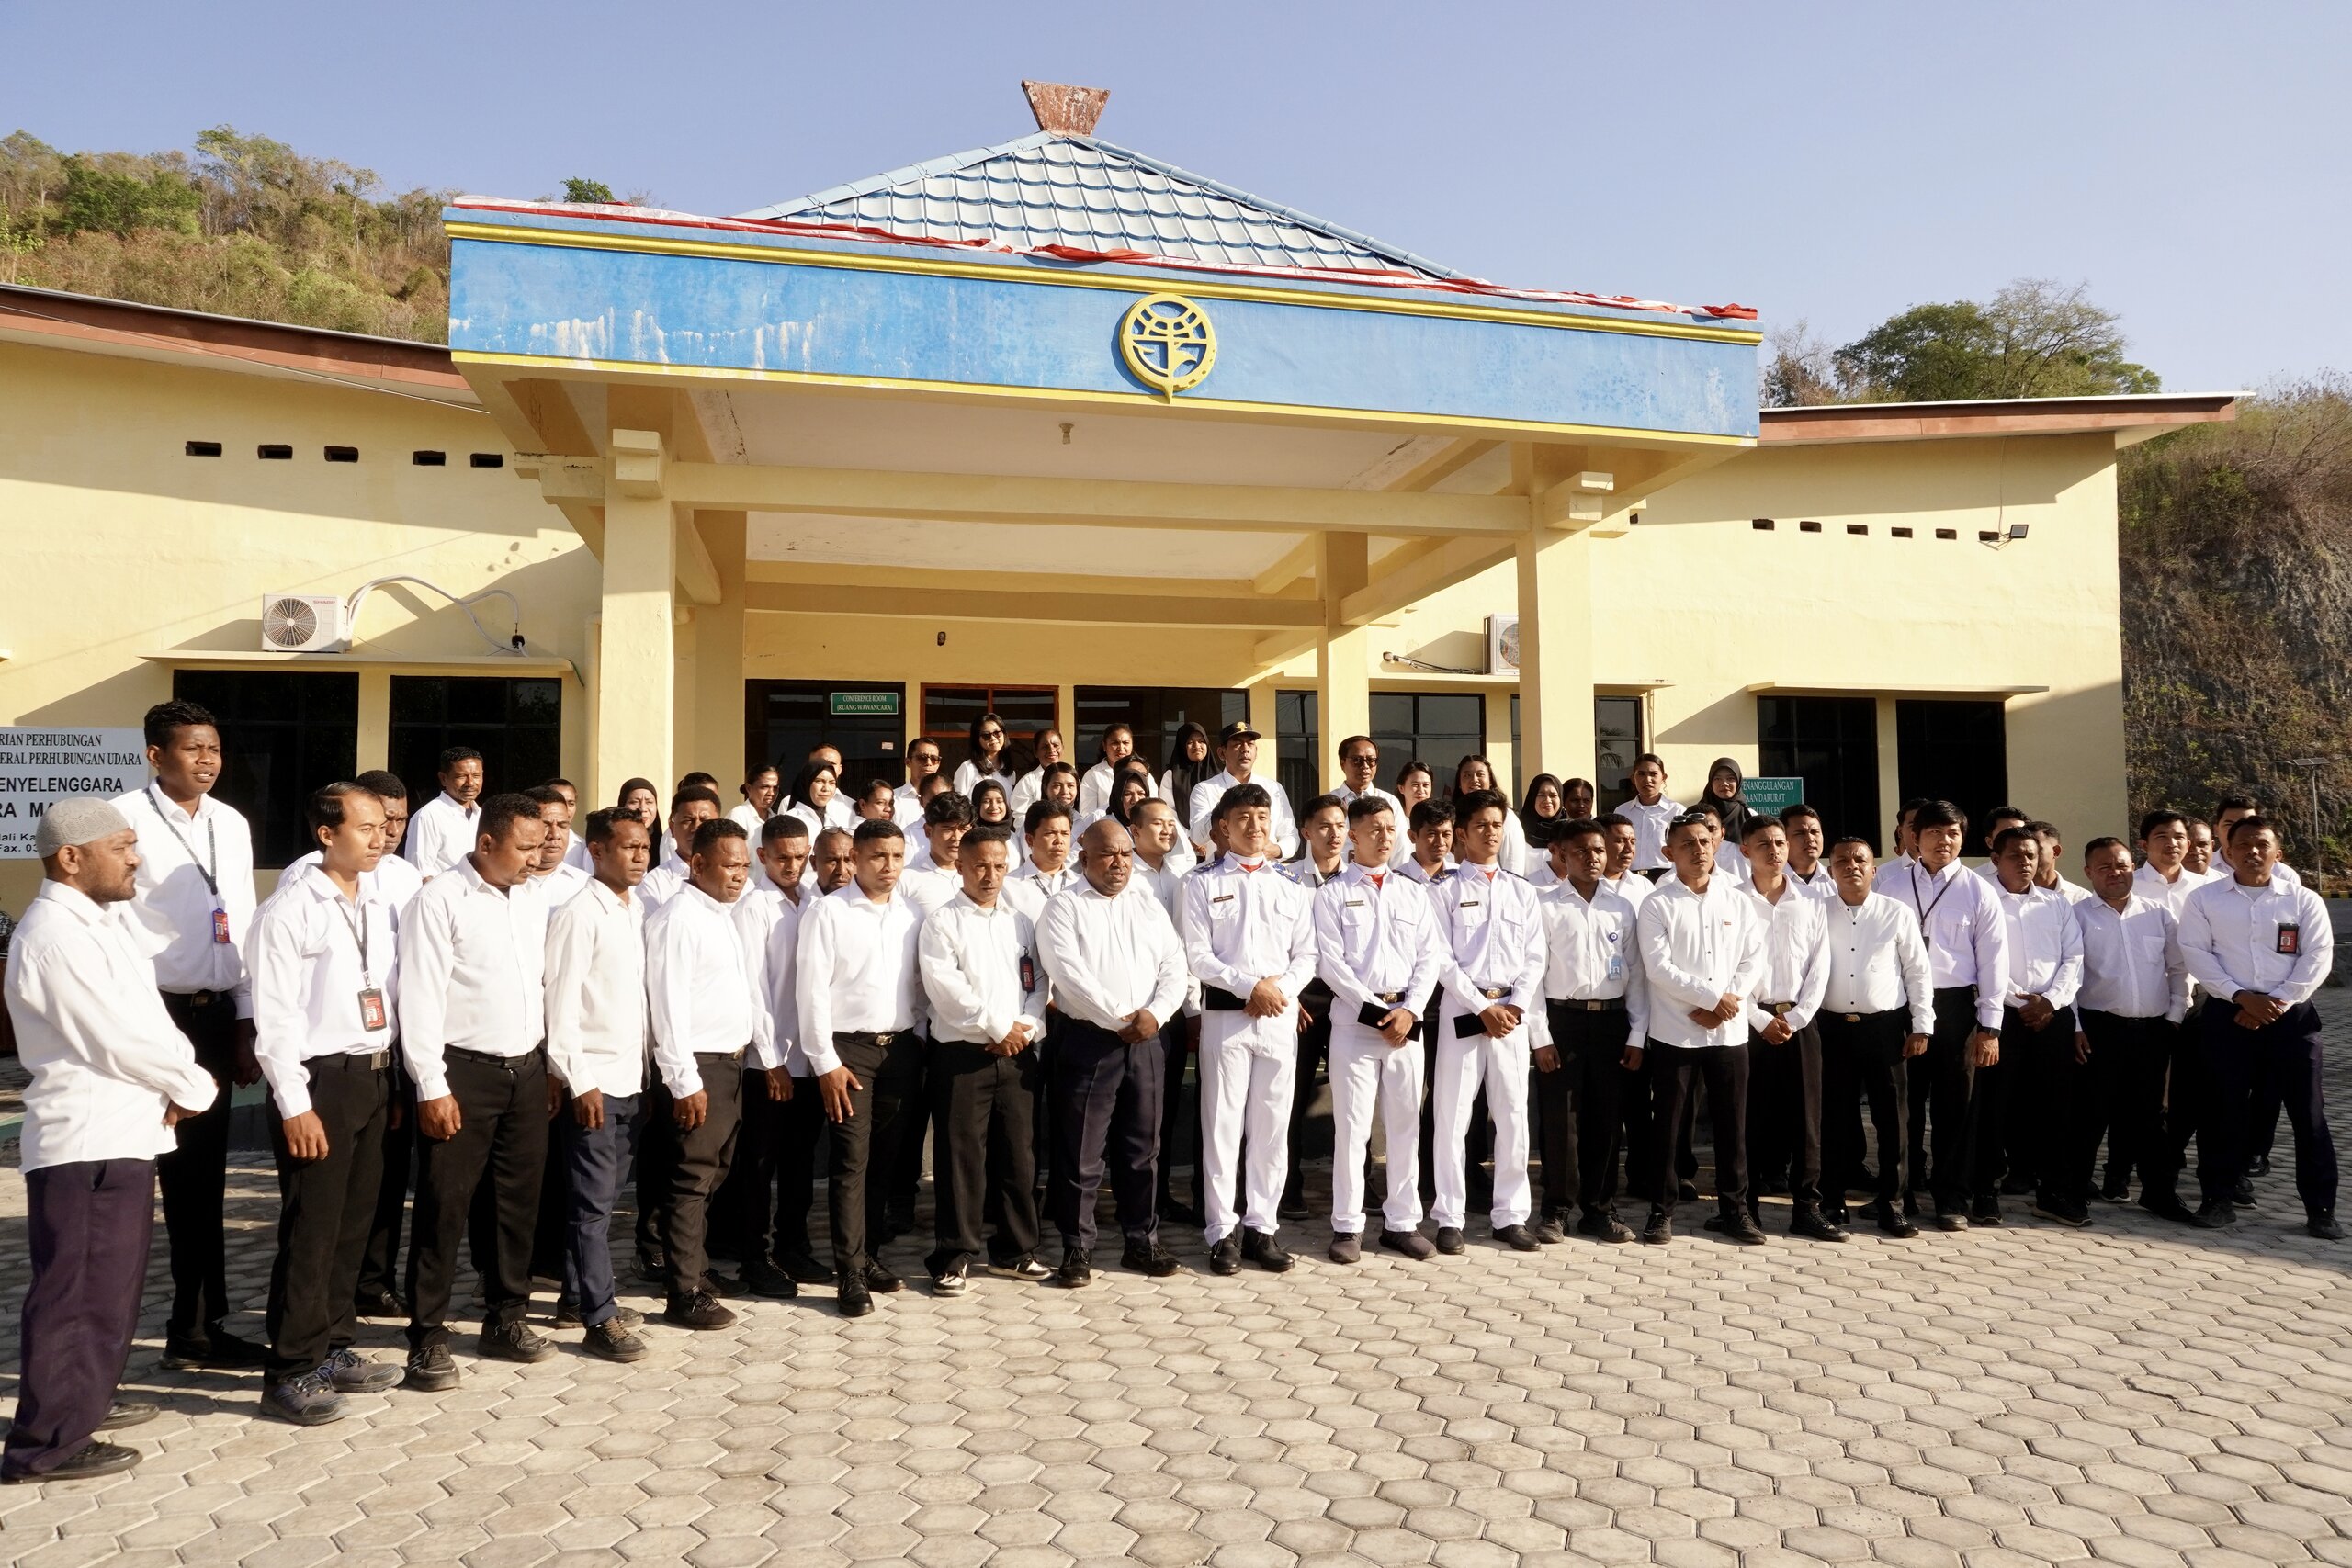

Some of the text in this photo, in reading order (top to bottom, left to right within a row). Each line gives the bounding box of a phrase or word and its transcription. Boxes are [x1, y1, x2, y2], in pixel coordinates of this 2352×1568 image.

[0, 733, 102, 747] RIAN PERHUBUNGAN
[0, 752, 142, 765] ERAL PERHUBUNGAN UDARA
[0, 777, 124, 792] ENYELENGGARA
[1742, 781, 1794, 791] ENANGGULANGAN
[1744, 794, 1786, 803] AAN DARURAT
[0, 833, 16, 841] ali
